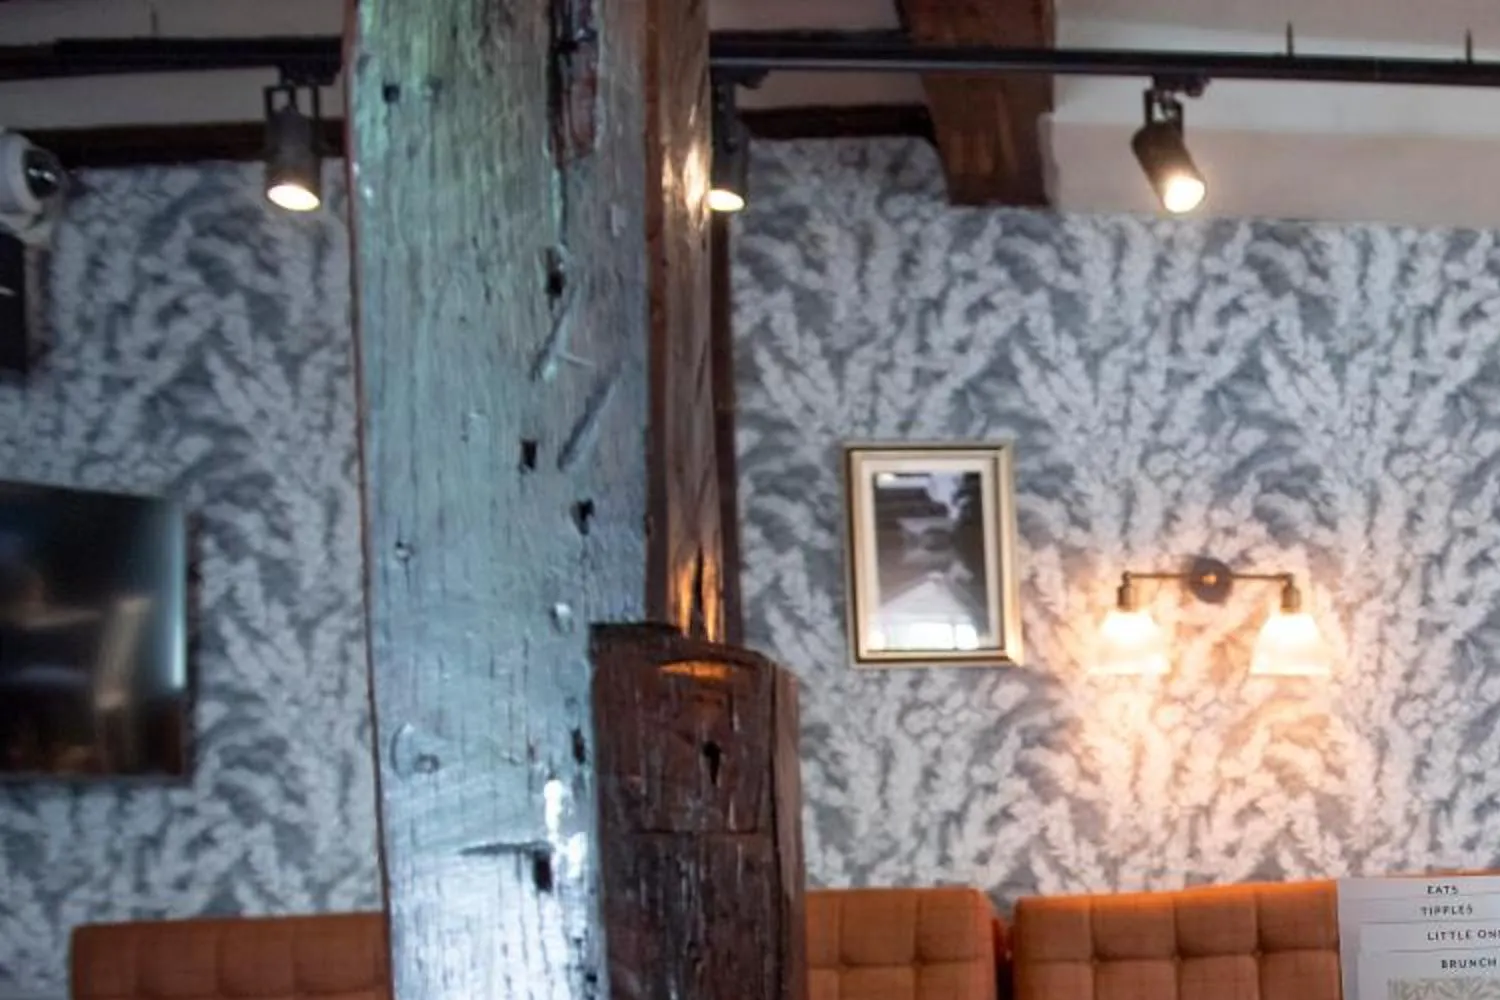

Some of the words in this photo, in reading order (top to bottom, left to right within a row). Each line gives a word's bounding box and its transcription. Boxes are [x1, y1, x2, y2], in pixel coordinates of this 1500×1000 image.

[1427, 885, 1459, 895] EATS
[1421, 903, 1473, 917] TIPPLES
[1427, 930, 1472, 941] LITTLE
[1441, 957, 1497, 969] BRUNCH
